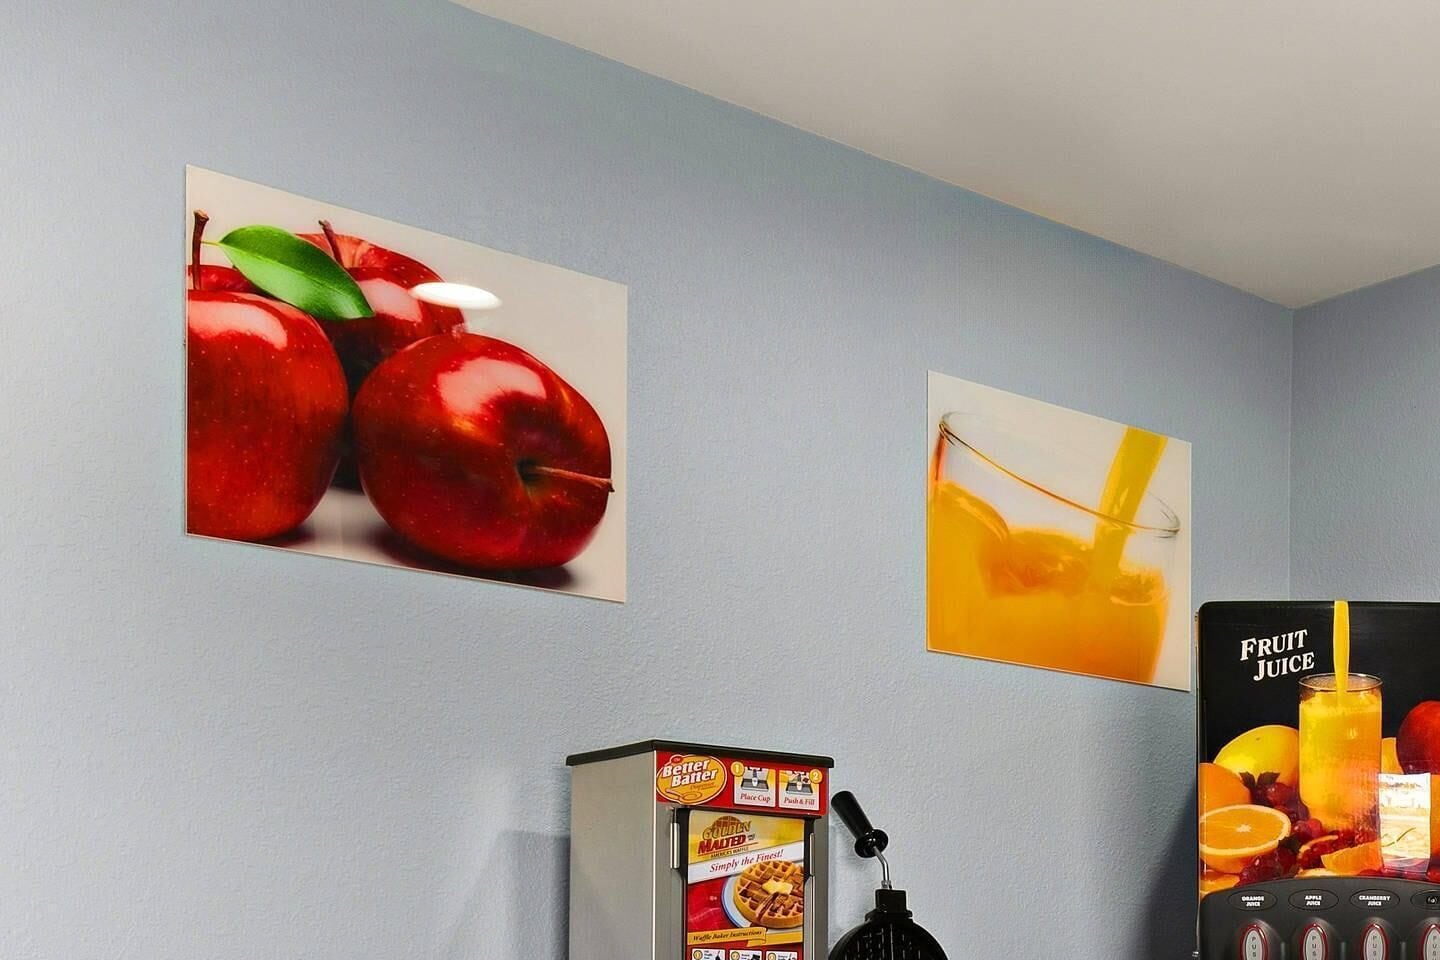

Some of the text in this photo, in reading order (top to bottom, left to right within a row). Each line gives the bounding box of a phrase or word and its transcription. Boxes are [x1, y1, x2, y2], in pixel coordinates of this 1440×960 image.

[1239, 629, 1308, 661] FRUIT
[1252, 652, 1315, 682] JUICE
[740, 793, 771, 803] Place Cup
[702, 821, 752, 841] GOLDEN
[698, 834, 747, 854] MALTED
[710, 848, 784, 873] Simply the Finest!
[693, 934, 711, 942] Waffle
